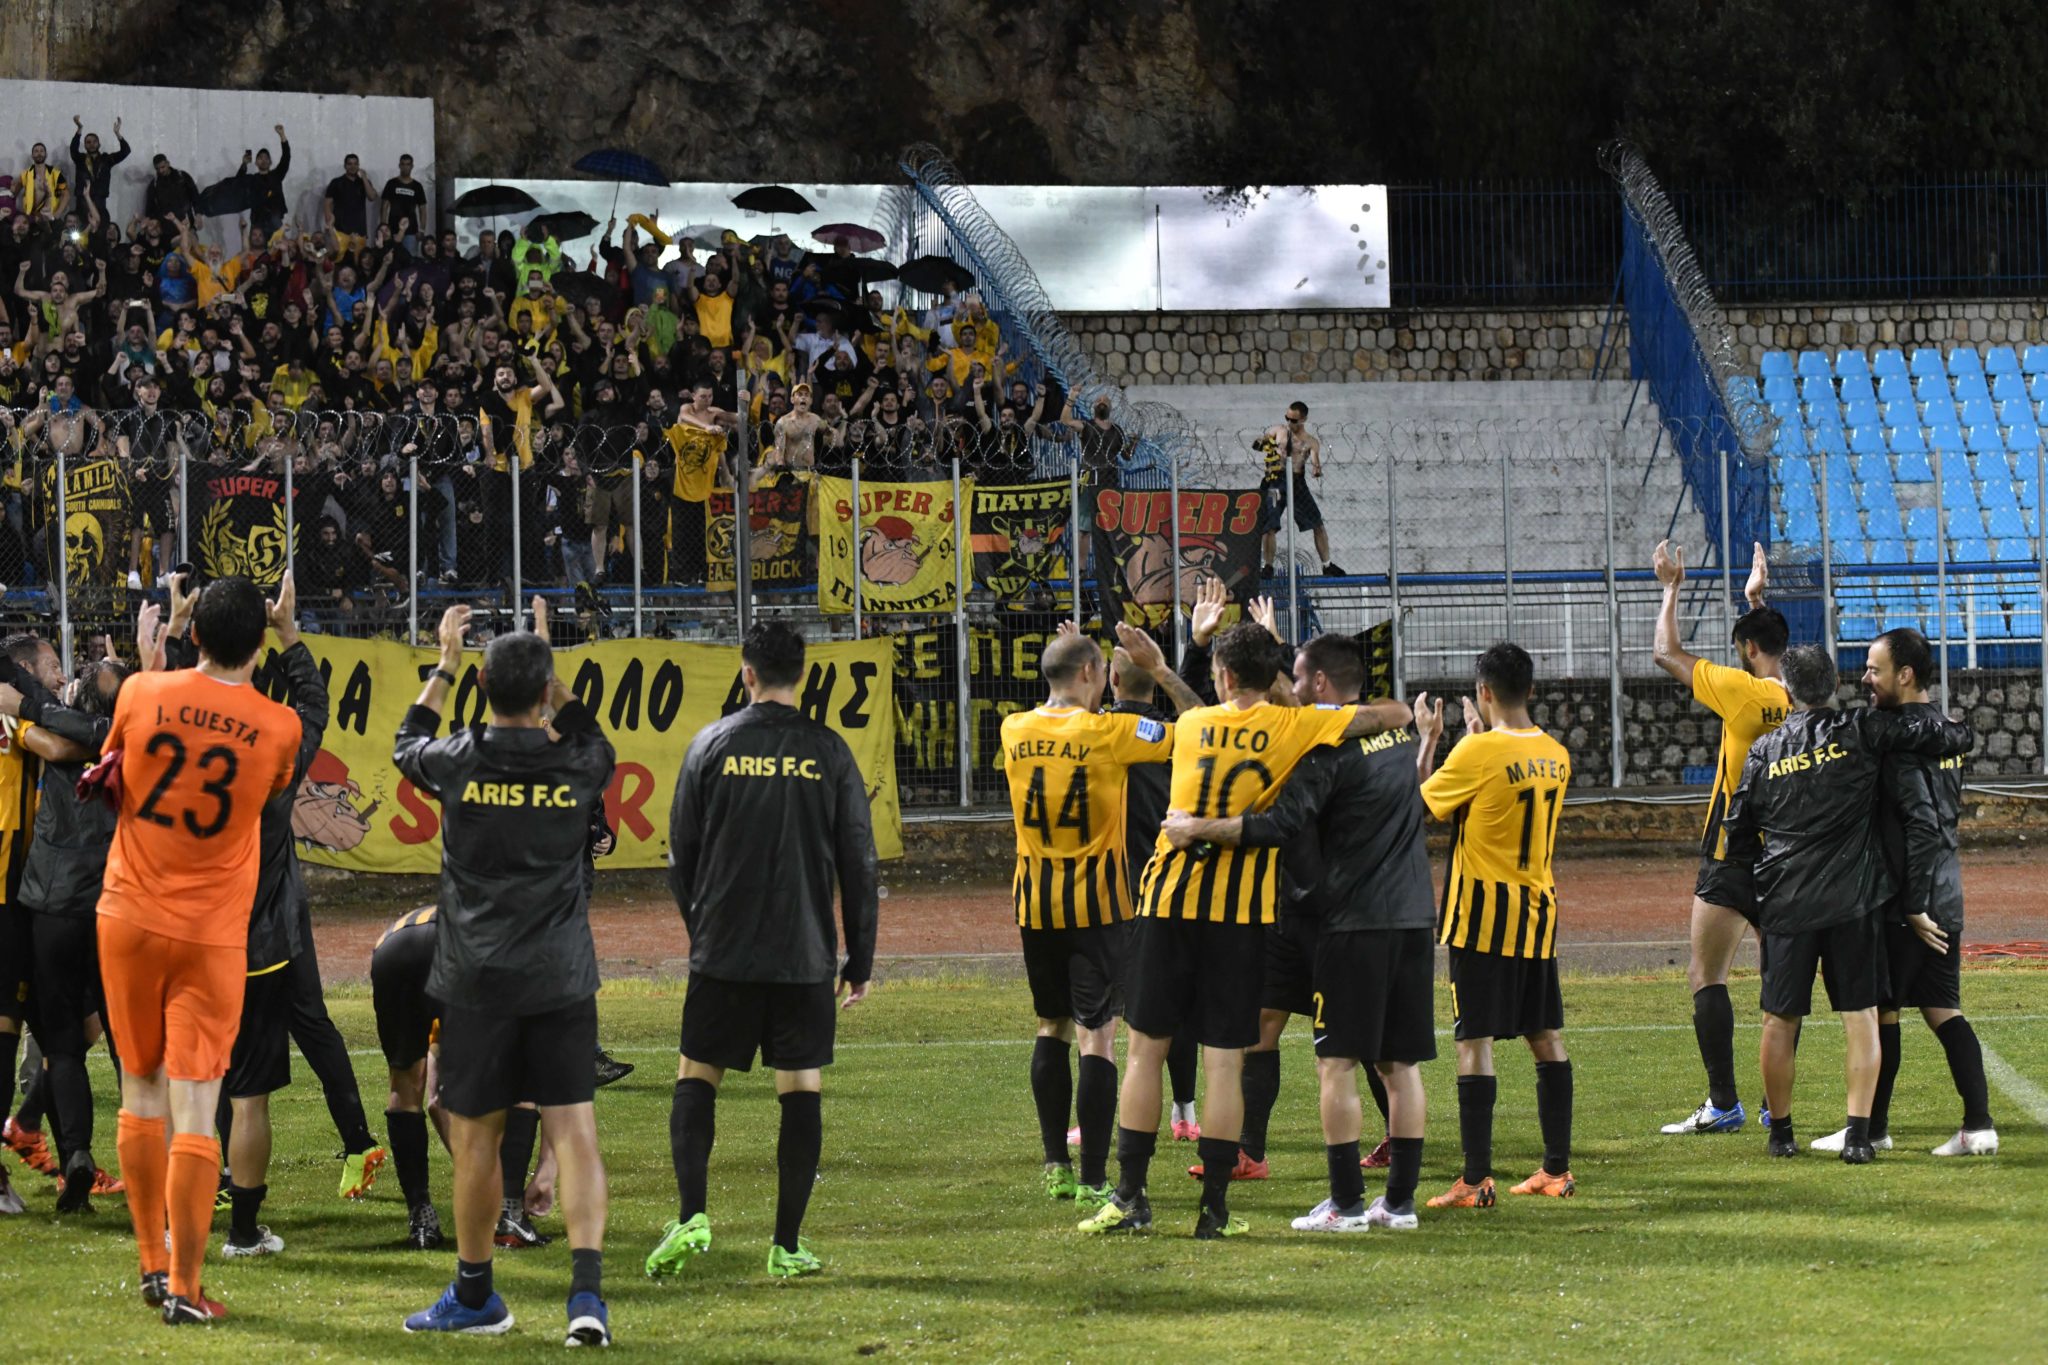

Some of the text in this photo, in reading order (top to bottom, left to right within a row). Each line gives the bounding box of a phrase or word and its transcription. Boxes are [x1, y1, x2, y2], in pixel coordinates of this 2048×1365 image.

[65, 465, 112, 494] LAMIA
[208, 476, 280, 499] SUPER
[65, 500, 86, 512] SOUTH
[835, 489, 955, 523] SUPER 3
[1096, 489, 1262, 535] SUPER 3
[751, 559, 802, 580] BLOCK
[156, 705, 260, 748] J. CUESTA
[1201, 726, 1270, 753] NICO
[1010, 740, 1091, 762] VELEZ A.V
[1768, 743, 1848, 780] ARIS F.C.
[722, 755, 822, 781] ARIS F.C.
[1505, 758, 1566, 785] MATEO
[136, 730, 239, 840] 23
[462, 781, 577, 808] ARIS F.C.
[1195, 754, 1274, 818] 10
[1022, 765, 1091, 848] 44
[1516, 785, 1559, 871] 11
[1312, 991, 1326, 1029] 2
